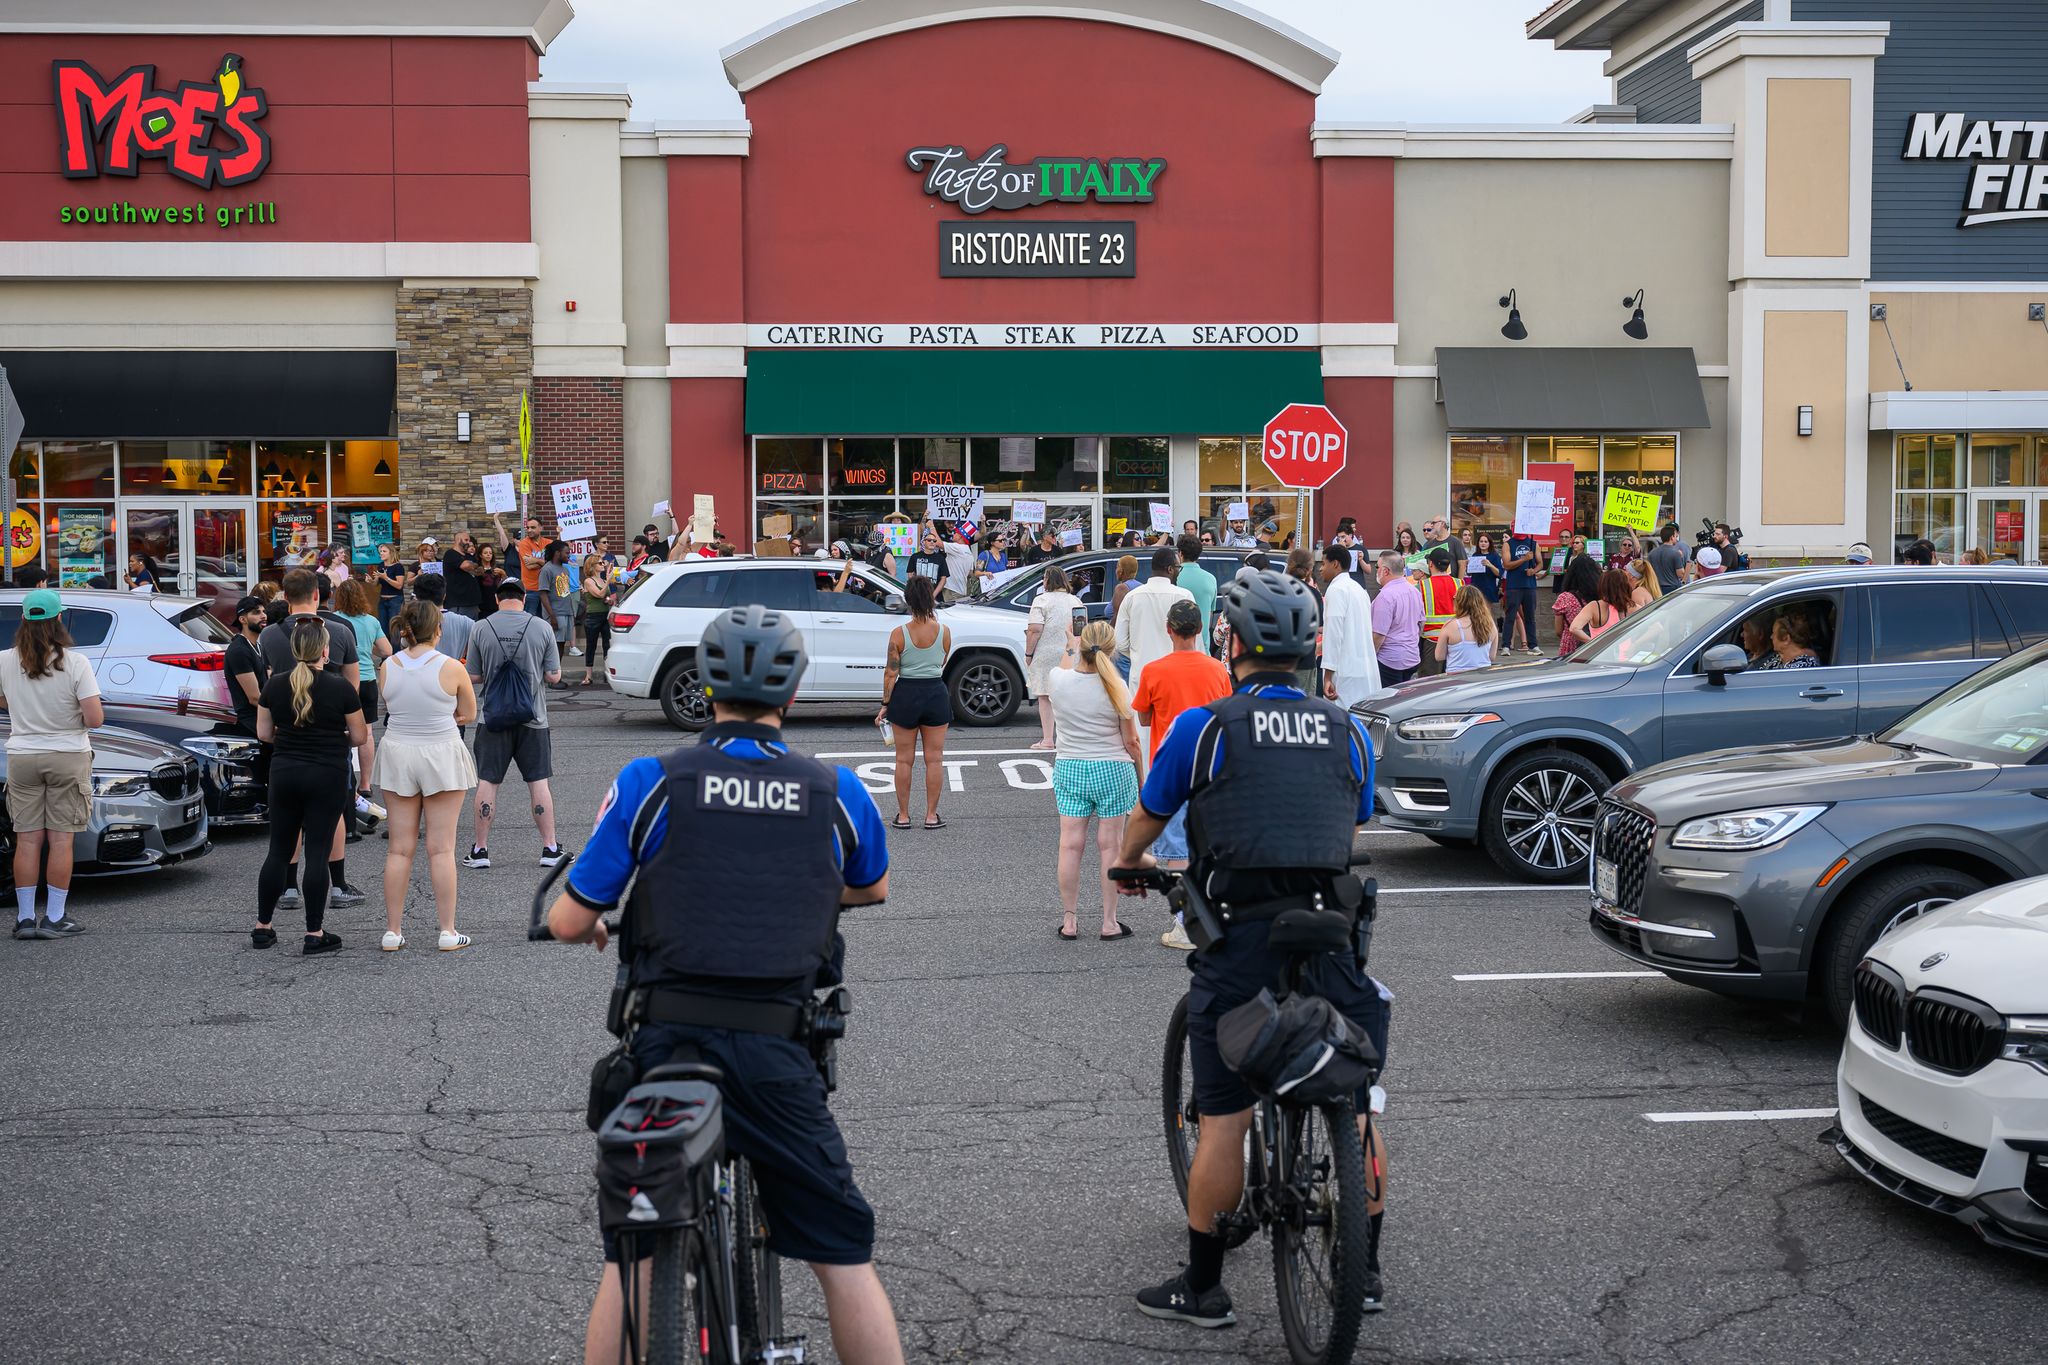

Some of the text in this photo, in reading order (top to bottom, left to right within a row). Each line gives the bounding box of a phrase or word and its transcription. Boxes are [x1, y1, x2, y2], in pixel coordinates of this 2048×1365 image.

[57, 58, 263, 180] MOE'S
[908, 148, 1160, 208] Taste OF ITALY
[60, 201, 276, 228] southwest grill
[951, 232, 1125, 265] RISTORANTE 23
[767, 326, 1299, 345] CATERING PASTA STEAK PIZZA SEAFOOD
[1269, 429, 1341, 463] STOP
[1119, 461, 1162, 474] OPEN
[763, 474, 805, 489] PIZZA
[845, 468, 887, 485] WINGS
[912, 472, 954, 487] PASTA
[559, 486, 583, 496] HATE
[561, 492, 588, 503] IS NOT
[930, 485, 984, 499] BOYCOTT
[566, 503, 579, 512] AN
[934, 498, 977, 508] TASTE OF
[1616, 491, 1649, 509] HATE
[556, 508, 593, 520] AMERICAN
[1620, 506, 1628, 514] IS
[277, 515, 313, 524] BURRITO
[563, 516, 594, 527] VALUE!
[1607, 512, 1650, 528] PATRIOTIC
[371, 524, 390, 532] MOE
[1253, 710, 1330, 745] POLICE
[704, 774, 801, 812] POLICE
